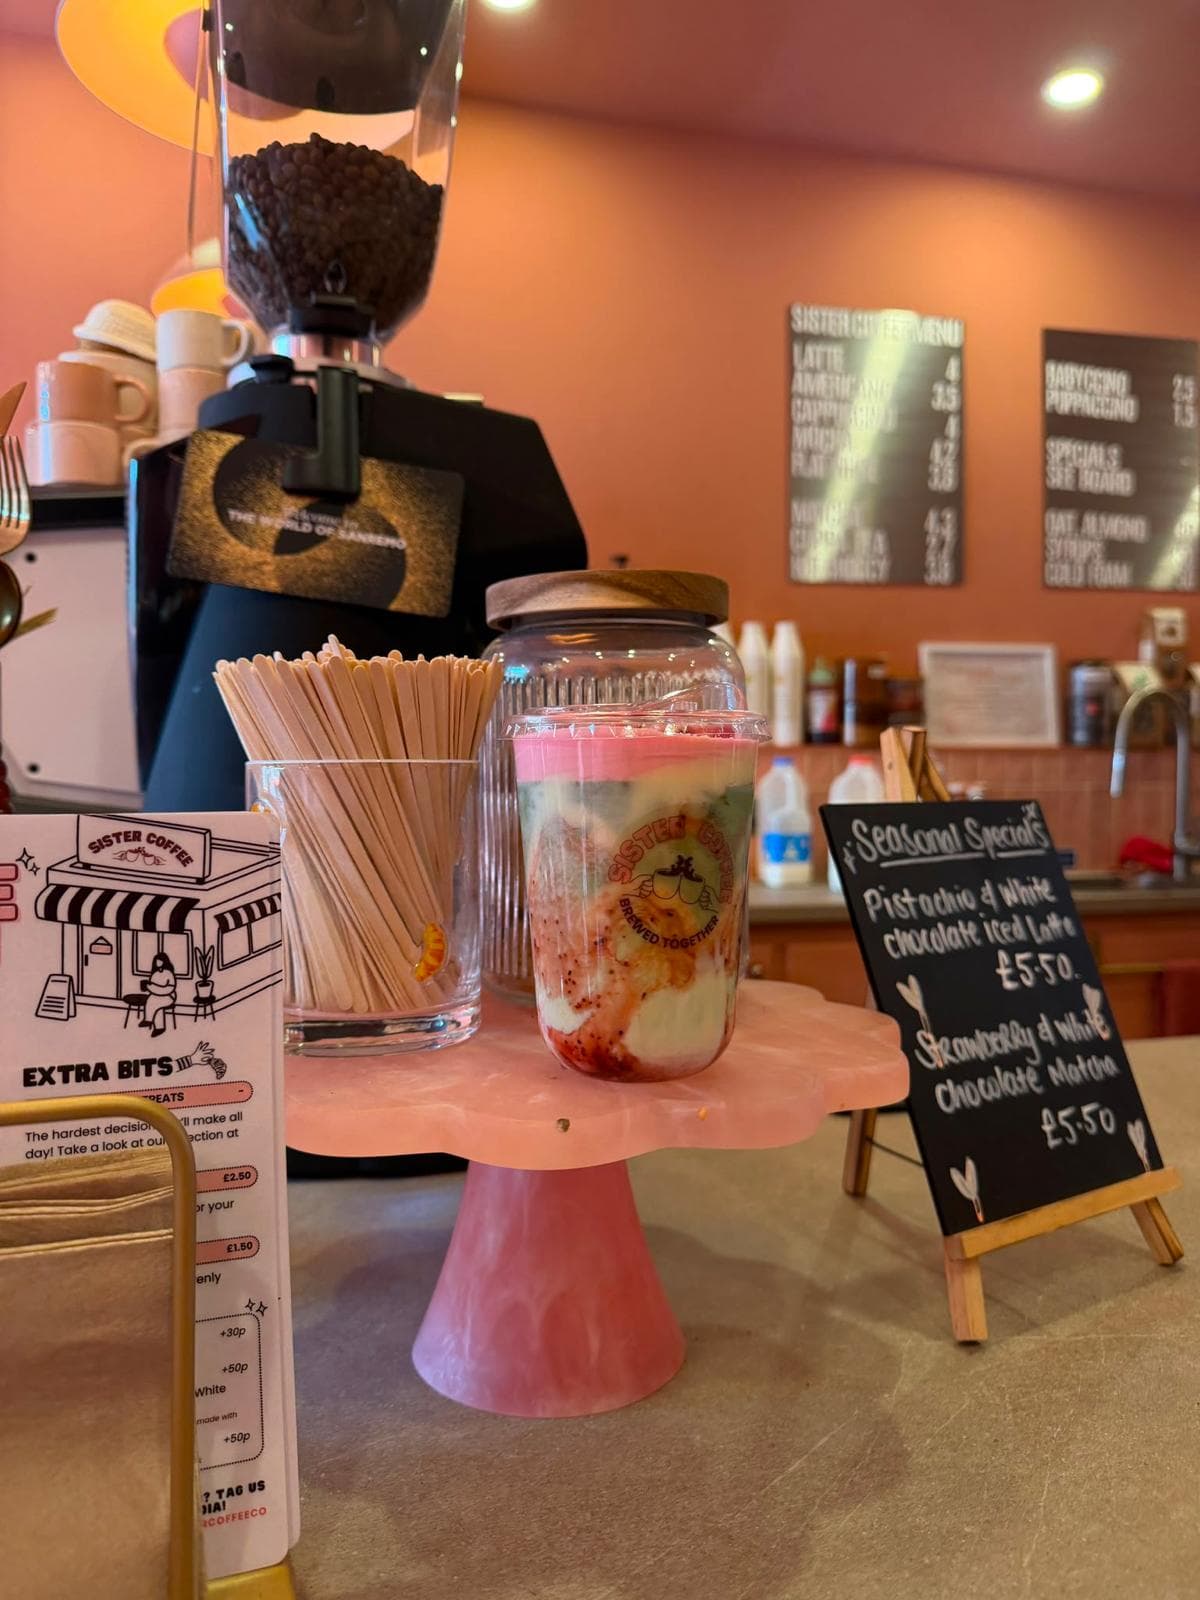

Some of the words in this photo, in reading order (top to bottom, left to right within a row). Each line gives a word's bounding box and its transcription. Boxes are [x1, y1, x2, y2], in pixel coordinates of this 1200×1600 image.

[791, 304, 849, 338] SISTER
[912, 316, 964, 347] MENU
[792, 343, 844, 373] LATTE
[228, 509, 256, 525] THE
[259, 514, 313, 534] WORLD
[314, 524, 337, 537] OF
[88, 830, 142, 854] SISTER
[146, 832, 194, 868] COFFEE
[608, 815, 687, 885] SISTER
[851, 818, 962, 862] Seasonal
[863, 884, 976, 923] Pistachio
[619, 898, 660, 945] BREWED
[662, 915, 719, 949] TOGETHER
[22, 1063, 110, 1088] EXTRA
[117, 1056, 174, 1080] BITS
[25, 1131, 49, 1143] The
[52, 1125, 101, 1139] hardest
[193, 1113, 226, 1126] make
[229, 1111, 243, 1122] all
[25, 1146, 54, 1160] day!
[58, 1143, 87, 1157] Take
[90, 1144, 99, 1153] a
[102, 1137, 128, 1151] look
[131, 1137, 144, 1149] at
[227, 1128, 239, 1138] at
[223, 1171, 252, 1183] £2.50
[208, 1199, 235, 1215] your
[226, 1241, 253, 1253] £1.50
[219, 1326, 247, 1339] +30p
[222, 1362, 249, 1374] +50p
[195, 1384, 226, 1398] White
[196, 1415, 220, 1425] made
[222, 1411, 238, 1421] with
[224, 1432, 251, 1443] +50p
[216, 1485, 244, 1500] TAG
[248, 1480, 266, 1493] US
